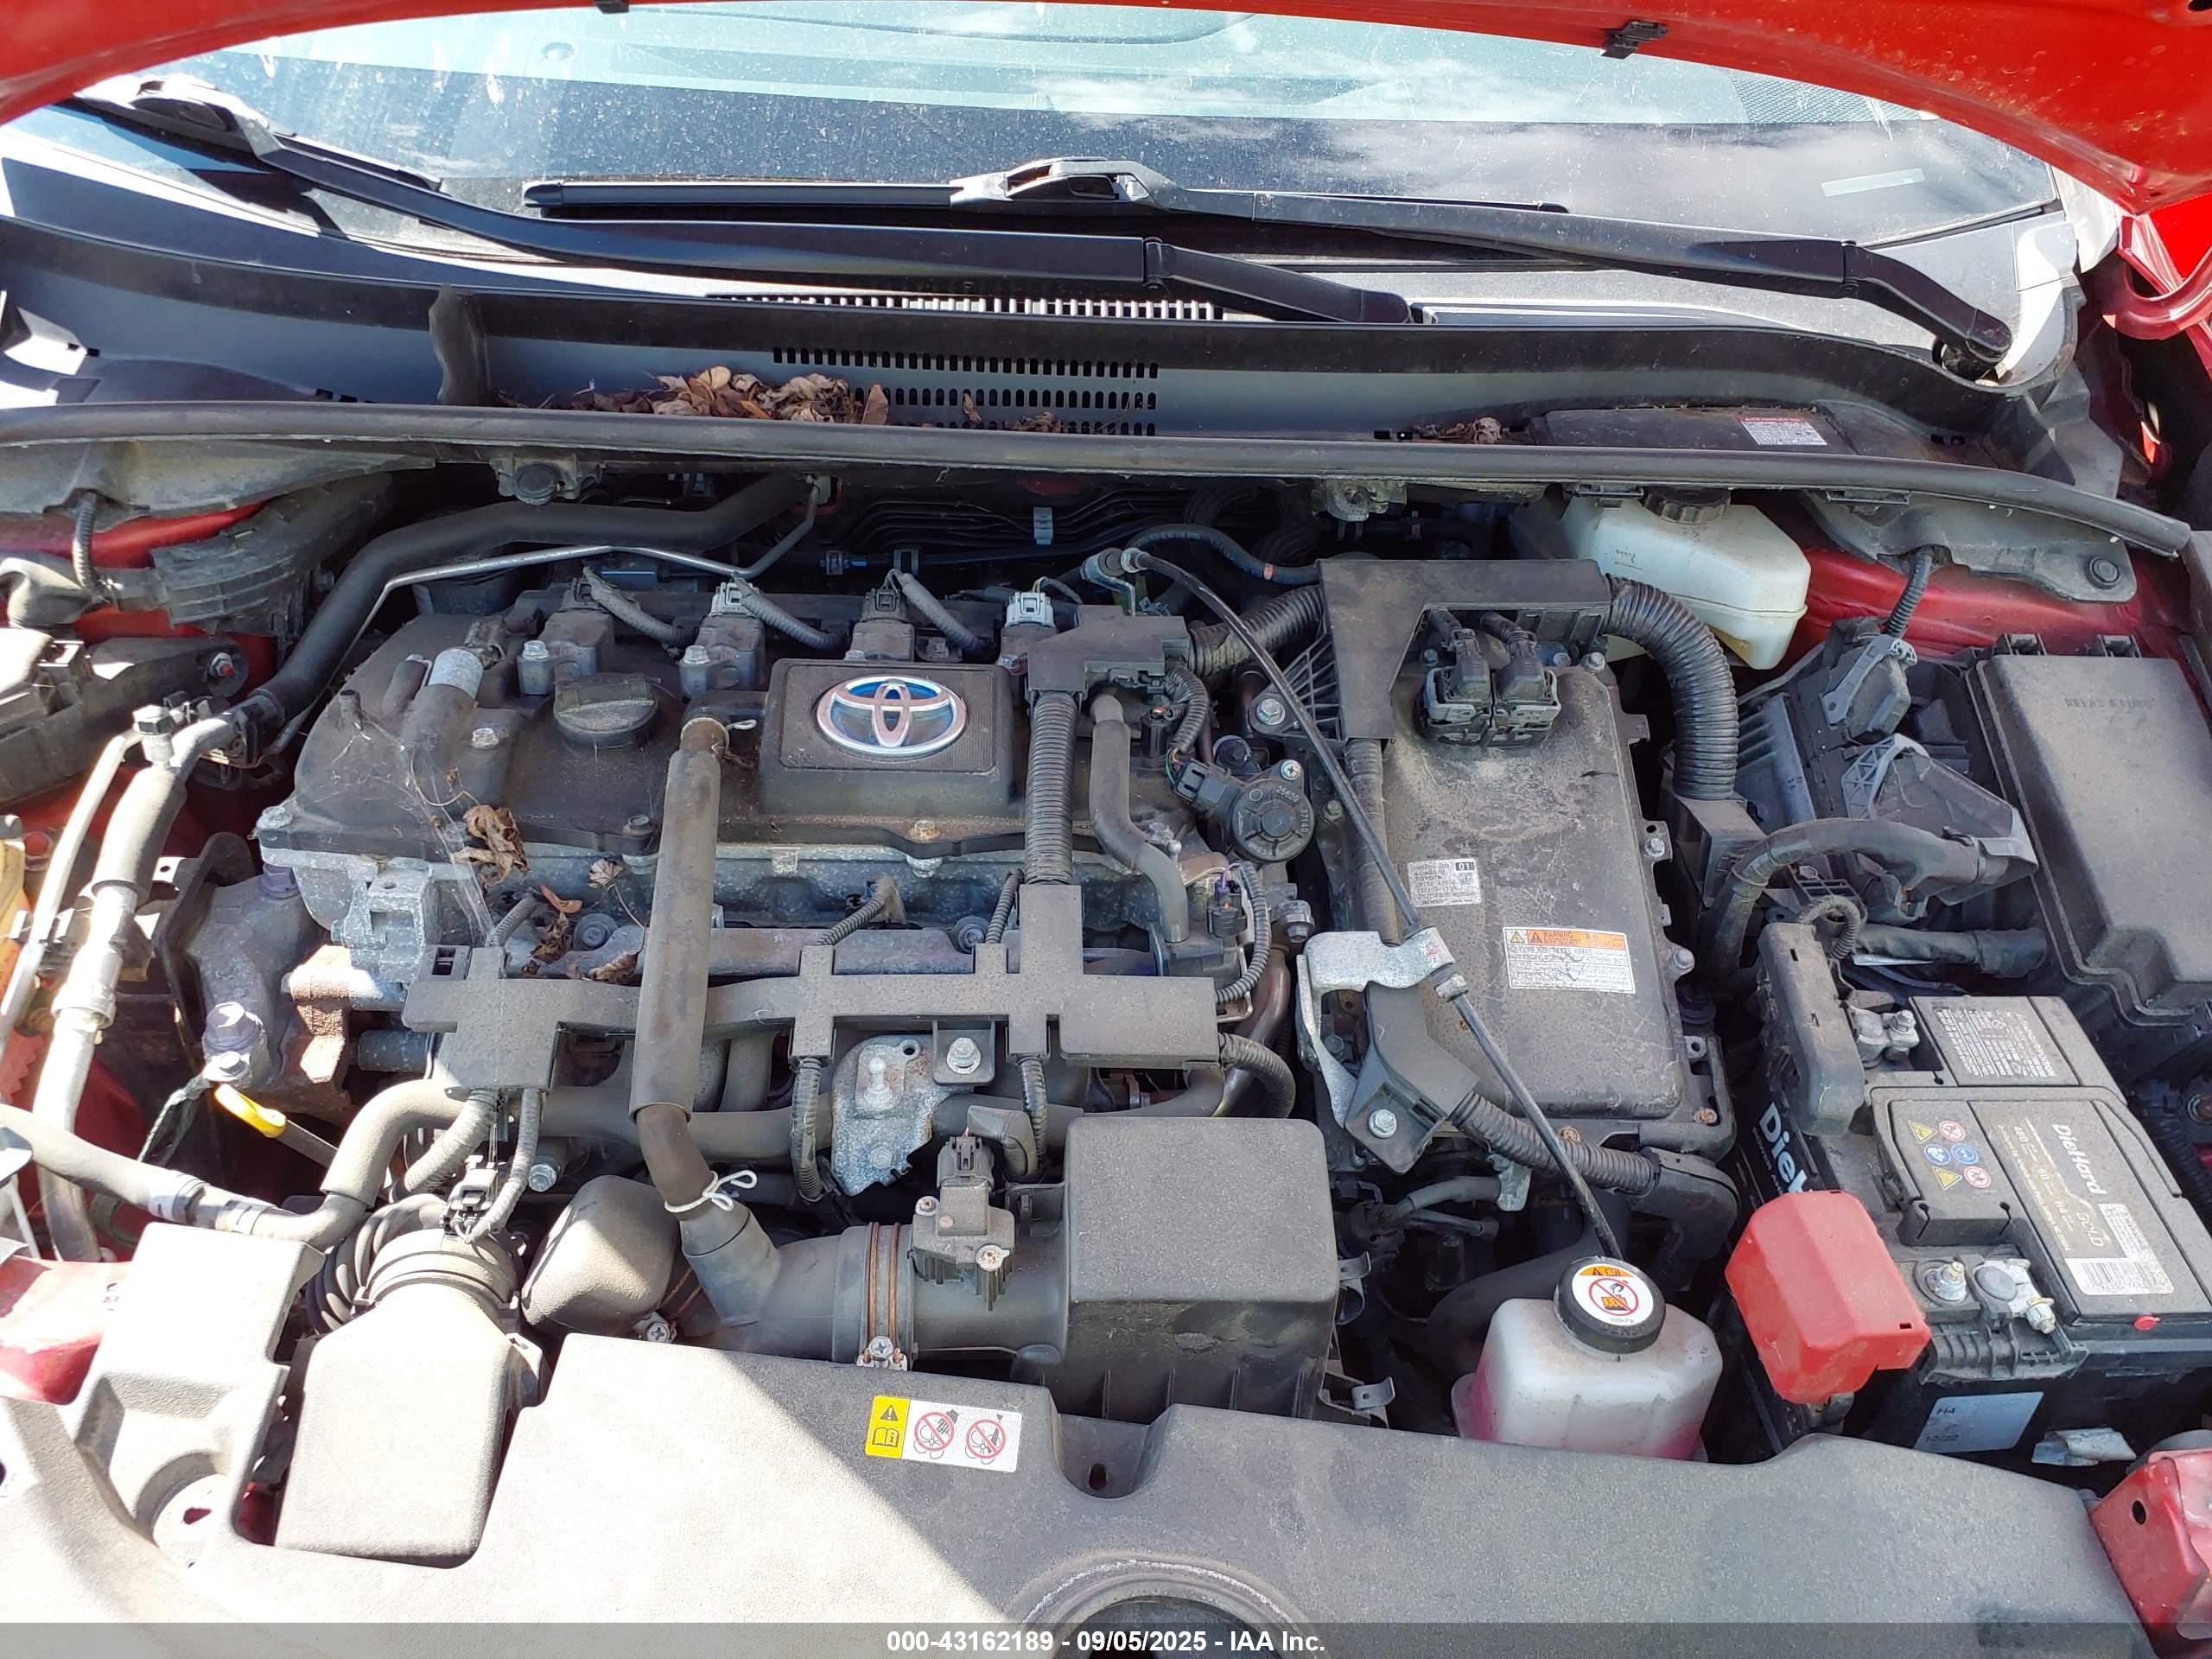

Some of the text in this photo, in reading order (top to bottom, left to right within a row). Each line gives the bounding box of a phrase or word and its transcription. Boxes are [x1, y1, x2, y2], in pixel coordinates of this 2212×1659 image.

[1274, 785, 1300, 803] 25620
[1300, 809, 1309, 832] 37140
[2051, 1124, 2107, 1195] DieHard
[2076, 1211, 2104, 1247] GOLD
